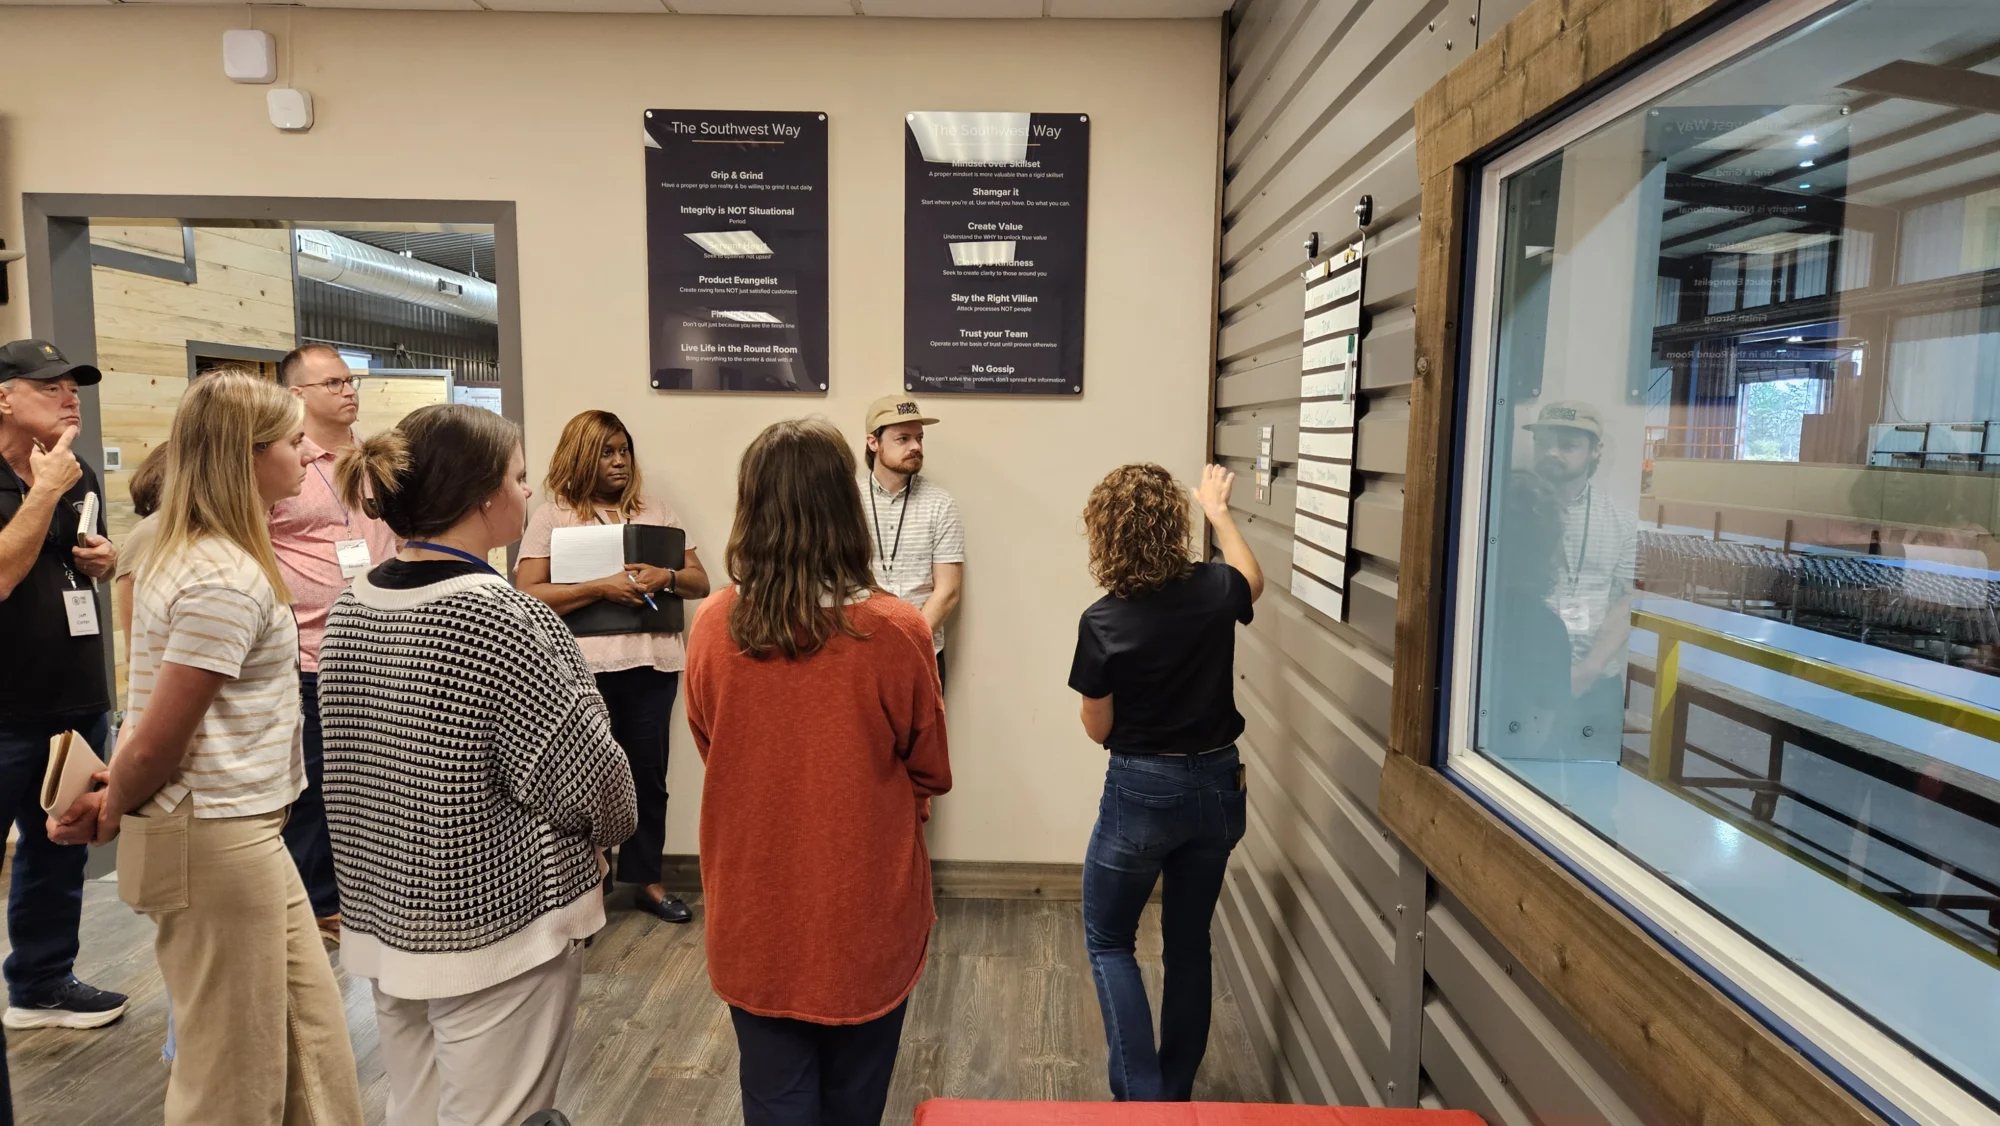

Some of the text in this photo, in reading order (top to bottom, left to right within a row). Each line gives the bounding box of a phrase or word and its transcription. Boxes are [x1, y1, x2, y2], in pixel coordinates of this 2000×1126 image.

[672, 122, 800, 139] The Southwest Way
[932, 124, 1061, 140] The Southwest Way
[1009, 160, 1040, 168] Skillset
[711, 171, 763, 181] Grip & Grind
[973, 188, 1019, 198] Shamgar it
[680, 206, 794, 216] Integrity is NOT Situational
[968, 222, 1023, 230] Create Value
[956, 259, 982, 268] Clarity
[699, 276, 778, 286] Product Evangelist
[951, 294, 1038, 304] Slay the Right Villian
[960, 329, 1028, 340] Trust your Team
[744, 345, 771, 353] Round
[773, 345, 798, 353] Room
[986, 365, 1015, 374] Gossip
